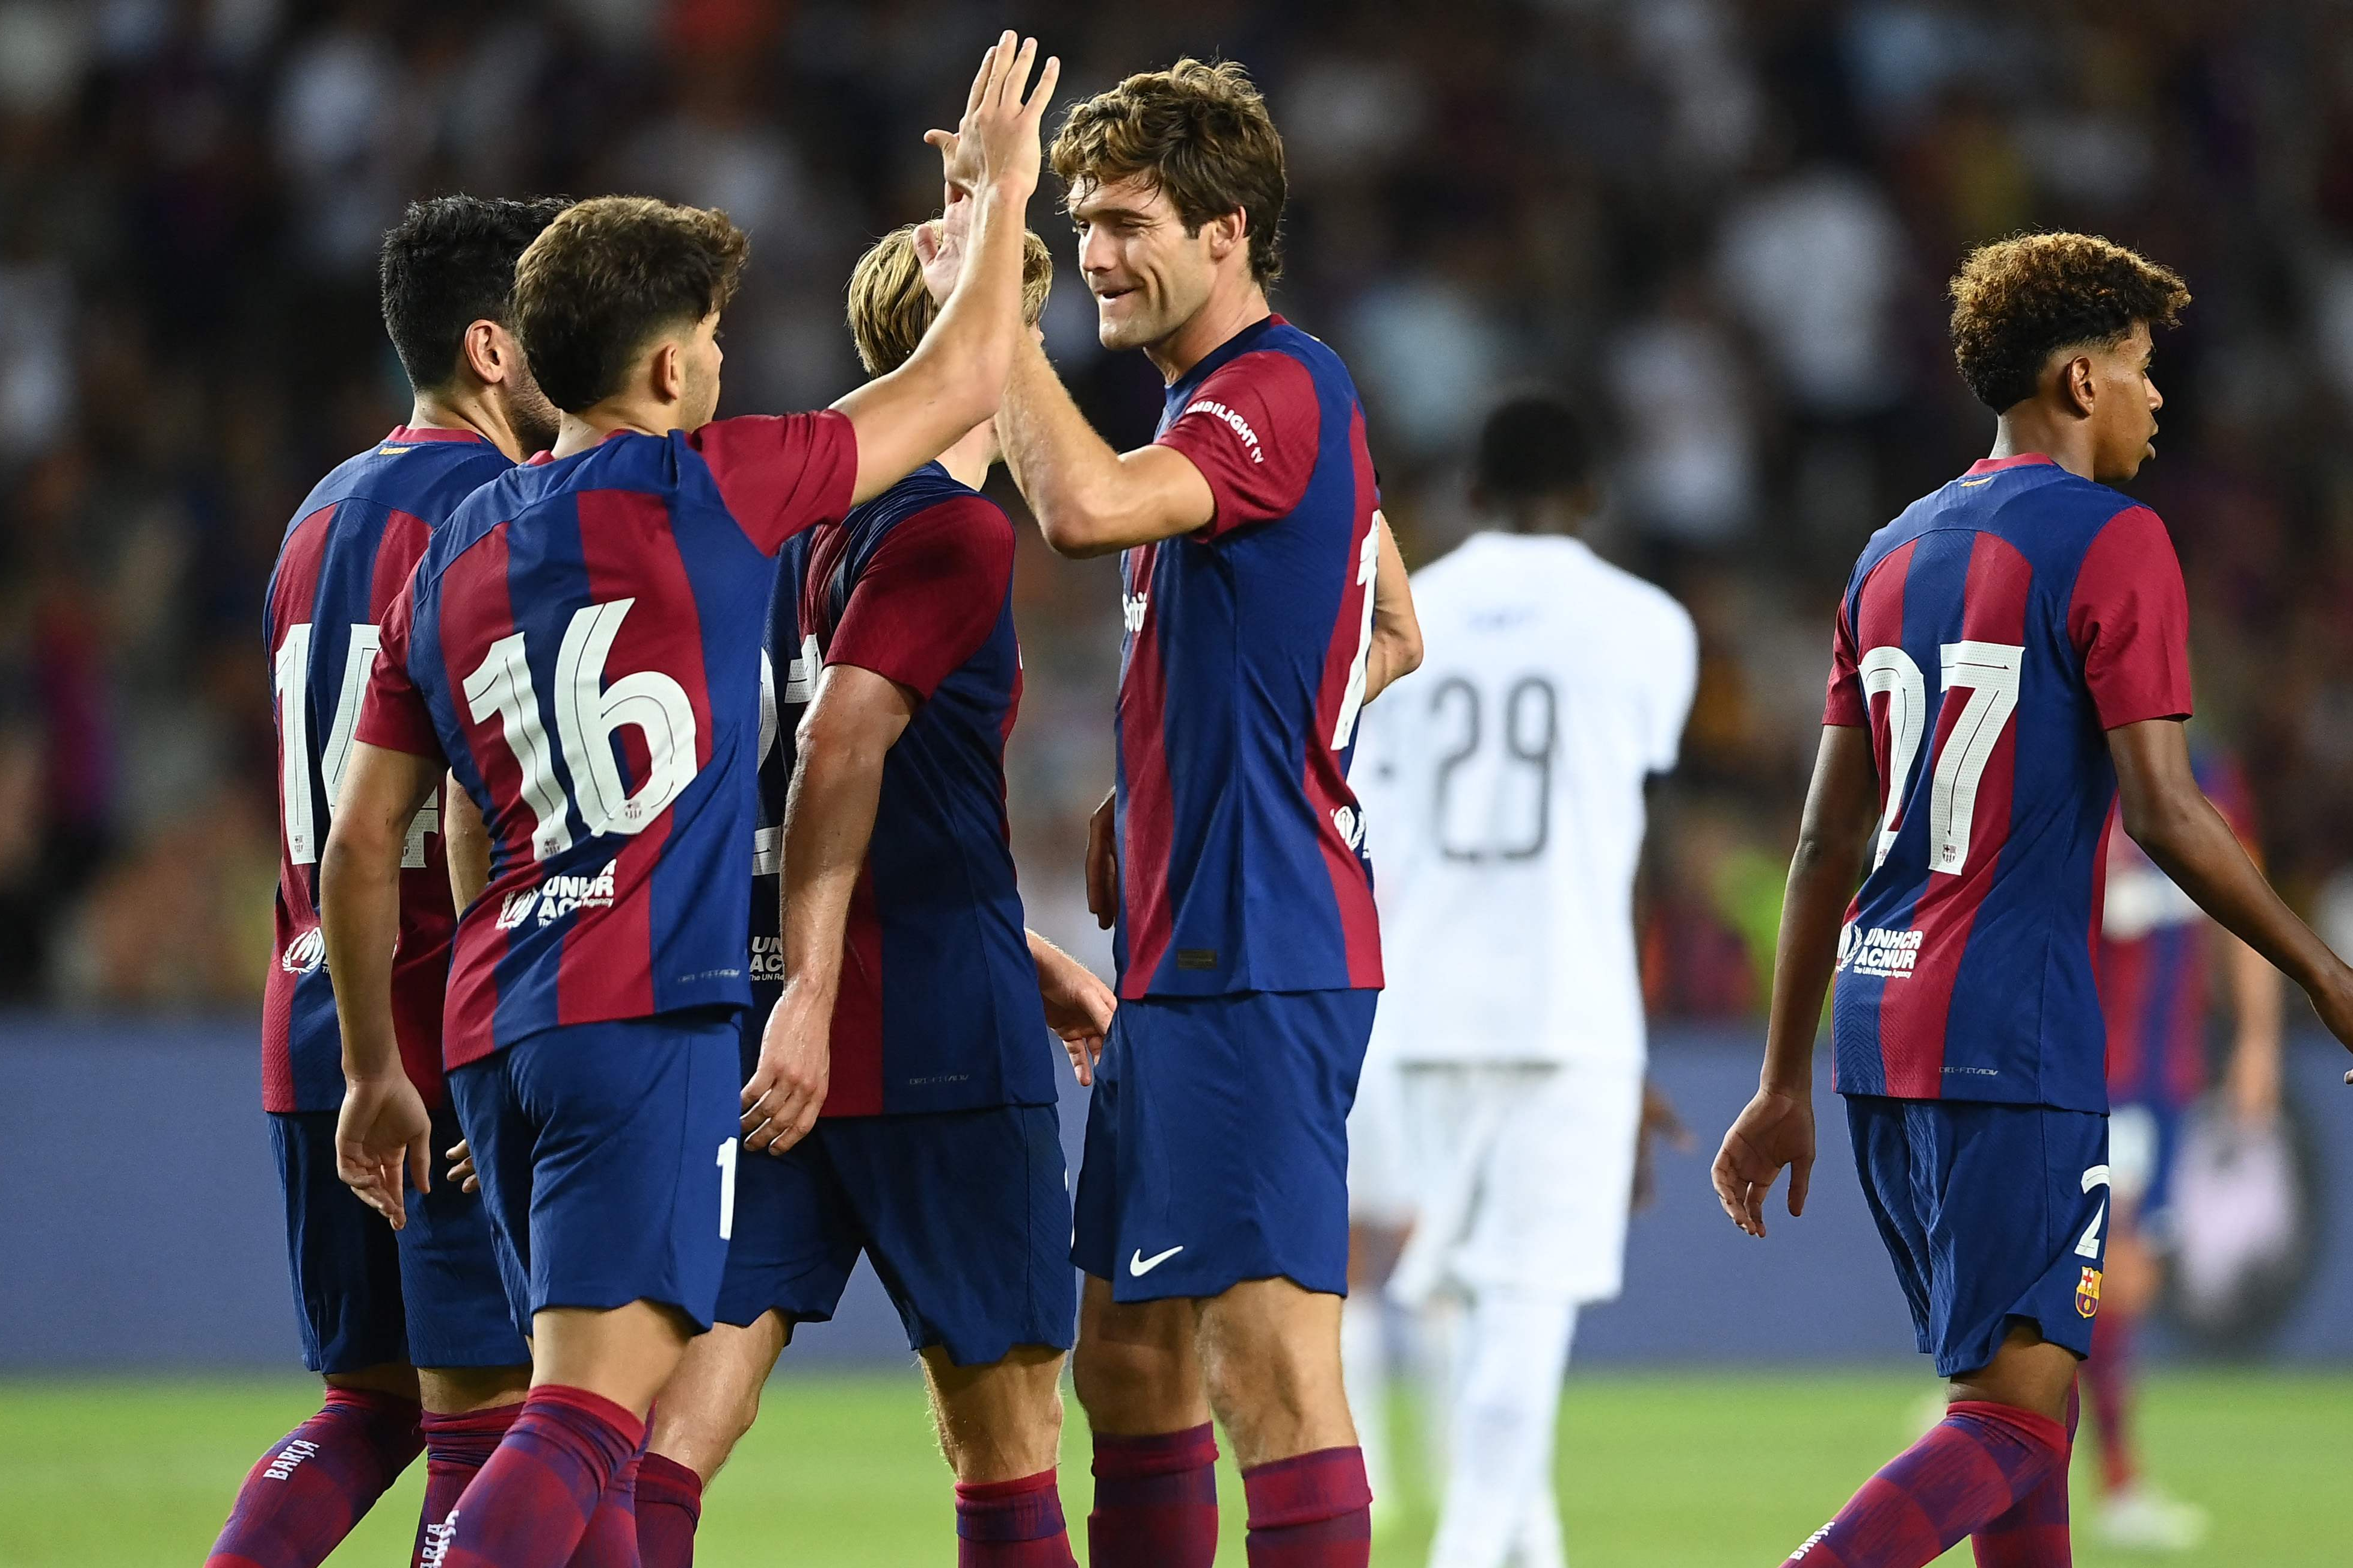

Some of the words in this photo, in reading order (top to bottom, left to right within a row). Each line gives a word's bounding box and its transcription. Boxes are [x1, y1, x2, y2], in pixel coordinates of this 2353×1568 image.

[463, 597, 698, 862] 16
[1428, 675, 1558, 863] 29
[1857, 640, 2026, 876] 27
[1854, 946, 1917, 970] ACNUR
[1864, 927, 1923, 950] UNHCR
[716, 1136, 738, 1241] 1
[263, 1439, 320, 1481] BARÇA
